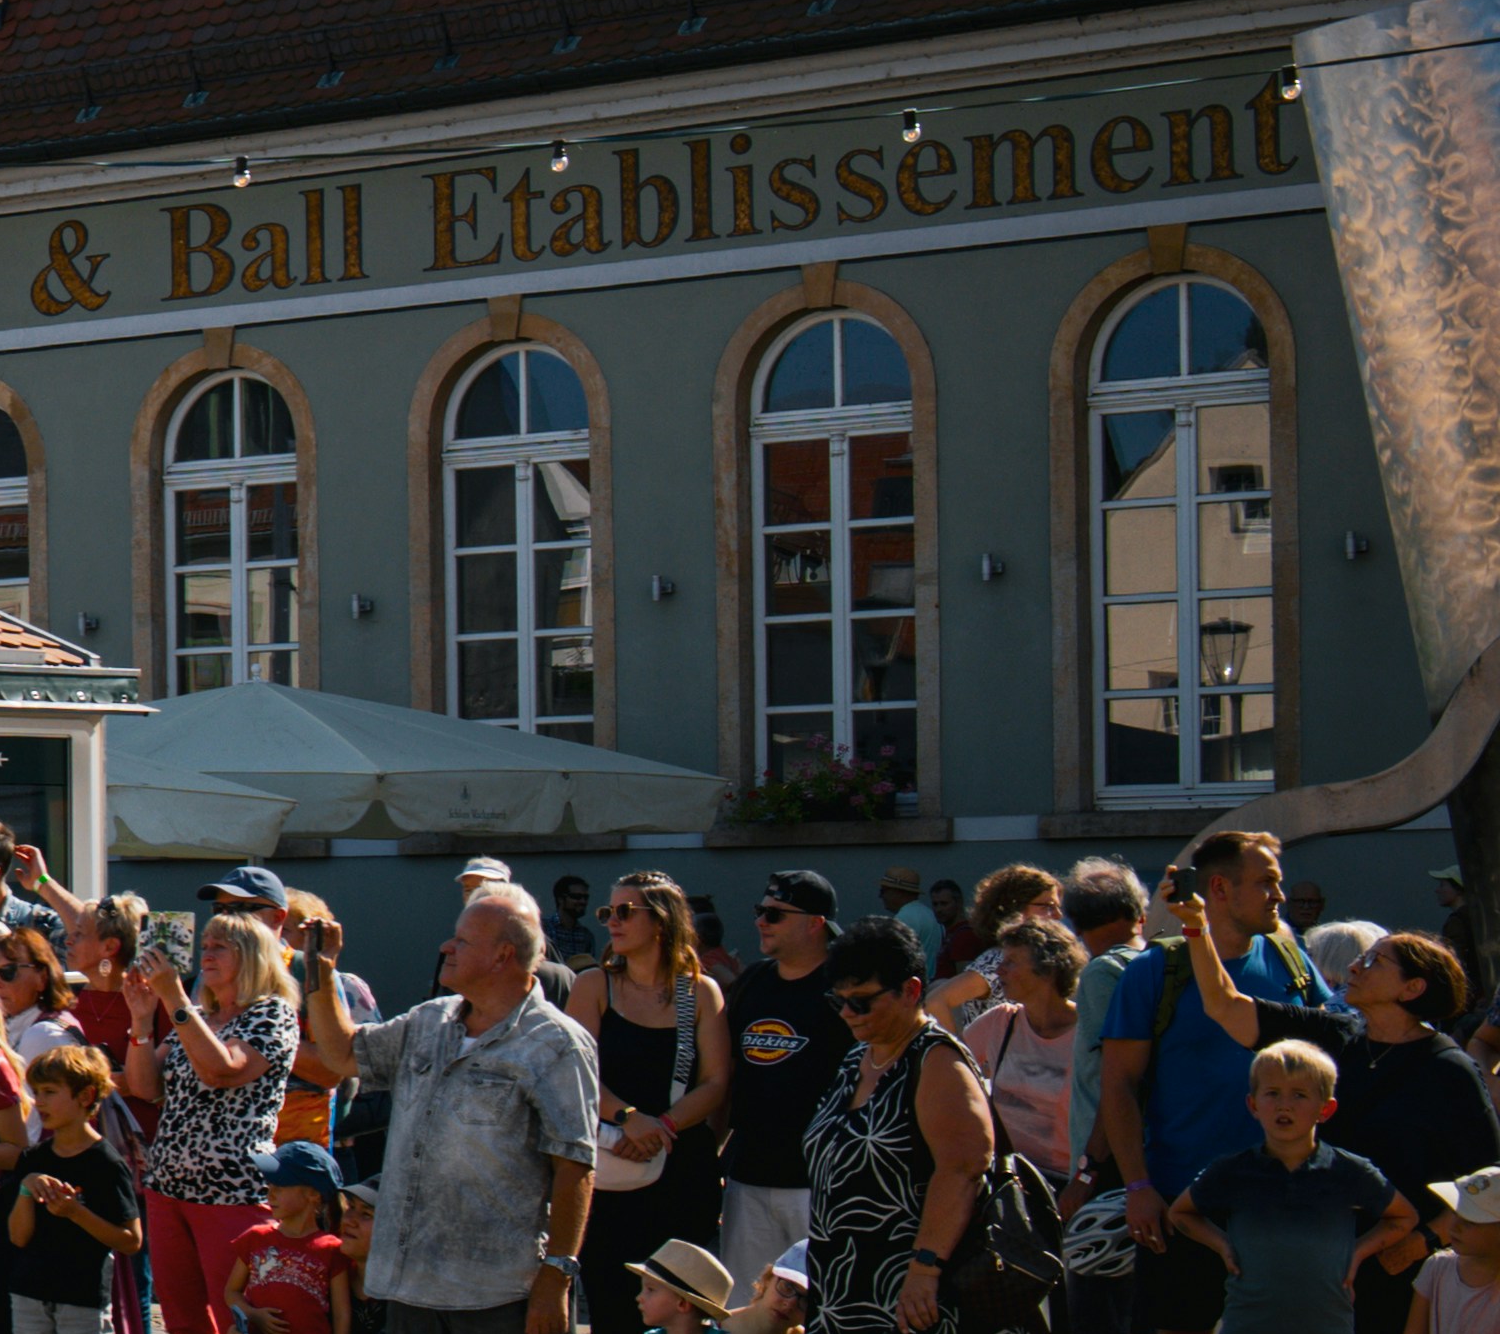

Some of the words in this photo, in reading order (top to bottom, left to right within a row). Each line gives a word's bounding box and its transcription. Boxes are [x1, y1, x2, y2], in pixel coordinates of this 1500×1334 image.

[30, 219, 112, 317] &
[160, 183, 370, 303] Ball
[422, 72, 1299, 273] Etablissement
[742, 1035, 799, 1049] Dickies
